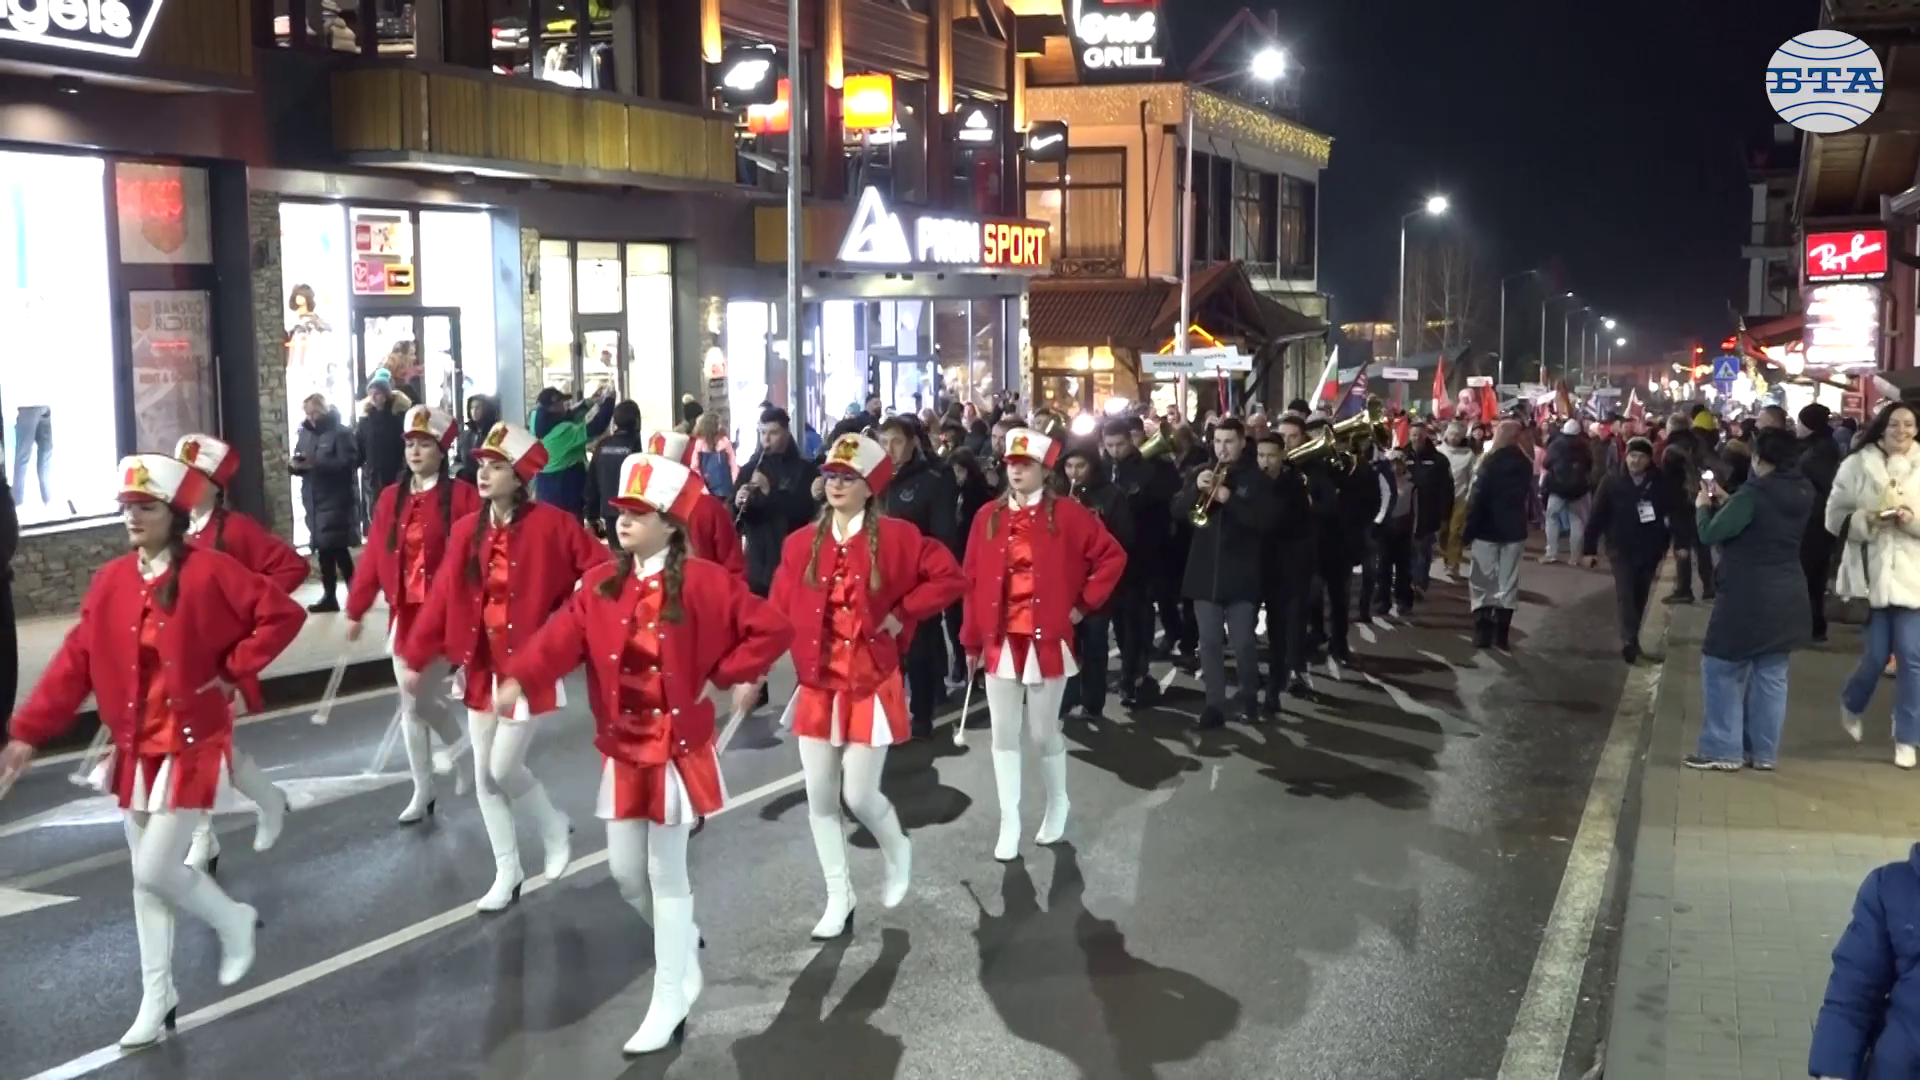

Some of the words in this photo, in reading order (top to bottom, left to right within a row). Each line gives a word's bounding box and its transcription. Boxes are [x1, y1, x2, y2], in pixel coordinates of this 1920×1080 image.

[0, 0, 132, 38] gels
[1083, 45, 1163, 68] GRILL
[984, 223, 1046, 265] SPORT
